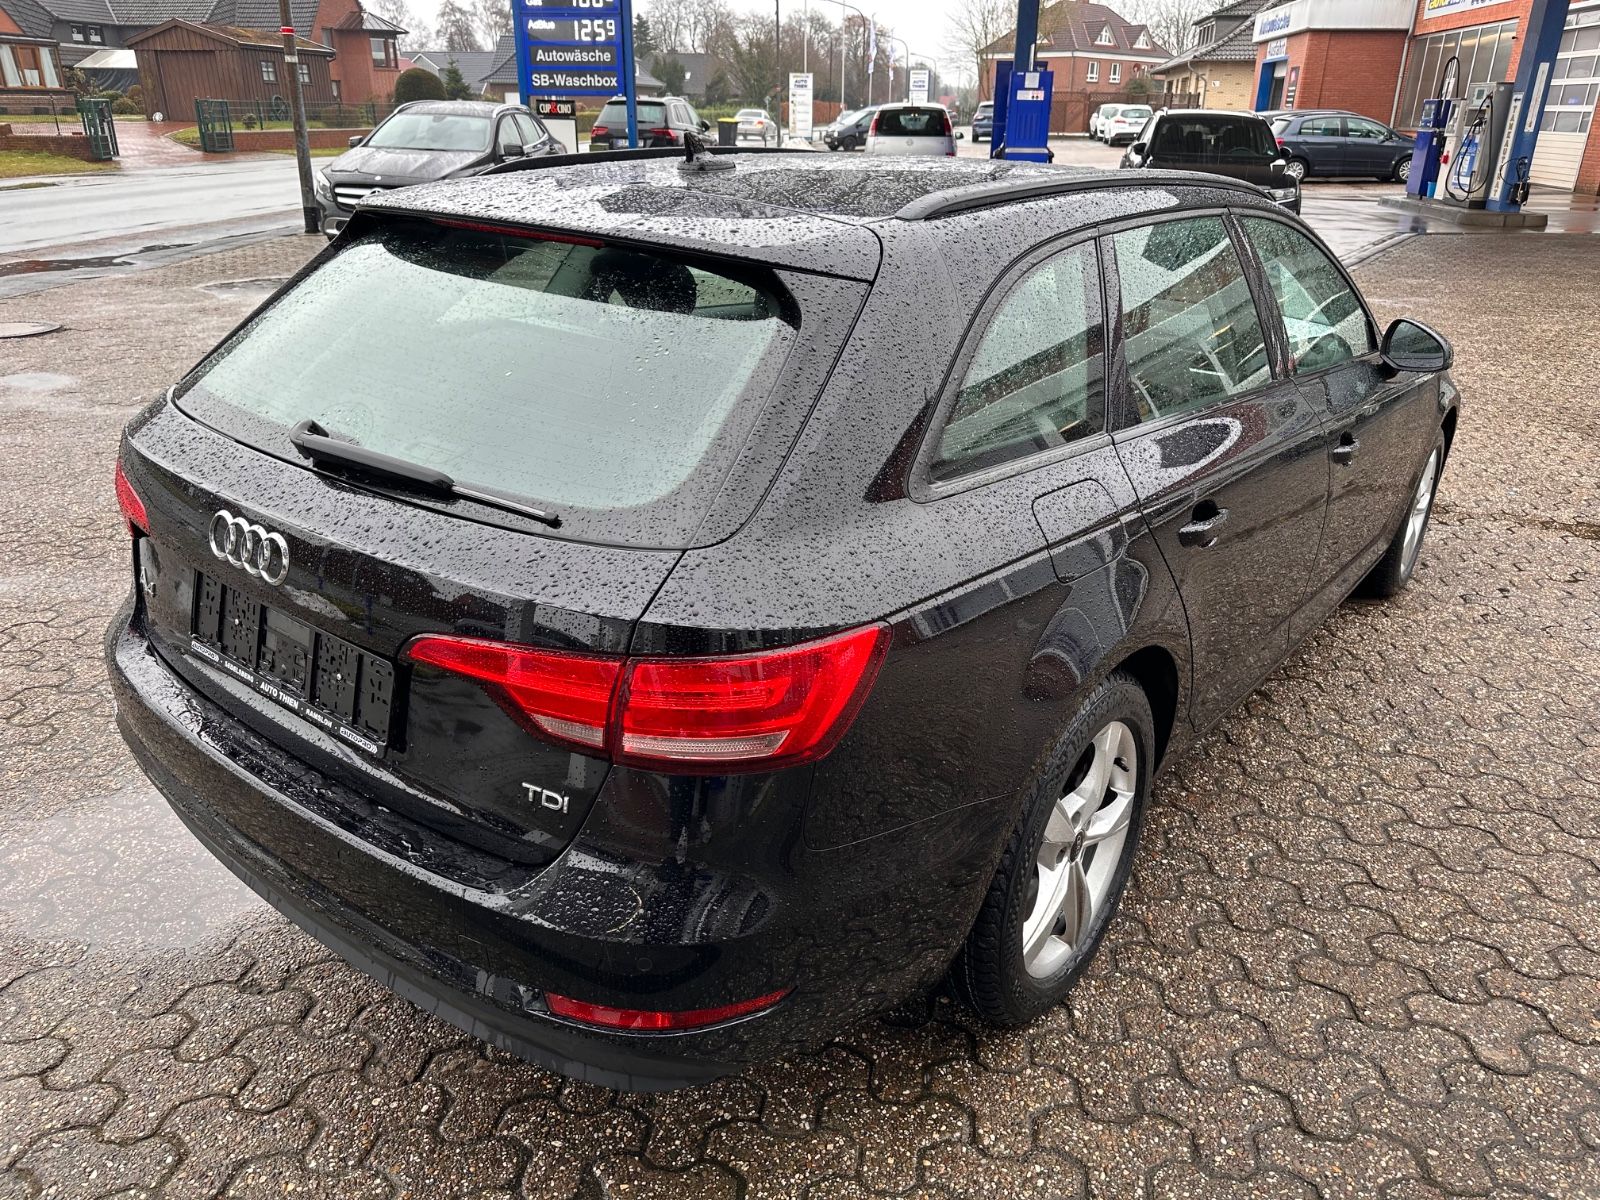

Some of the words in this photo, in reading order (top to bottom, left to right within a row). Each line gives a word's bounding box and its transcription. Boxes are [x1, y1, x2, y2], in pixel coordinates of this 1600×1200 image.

[527, 19, 556, 30] AdBlue
[536, 49, 611, 62] Autowäsche
[532, 73, 618, 87] SB-Waschbox
[260, 682, 278, 697] AUTO
[279, 692, 299, 710] THIEN
[522, 782, 570, 814] TDI
